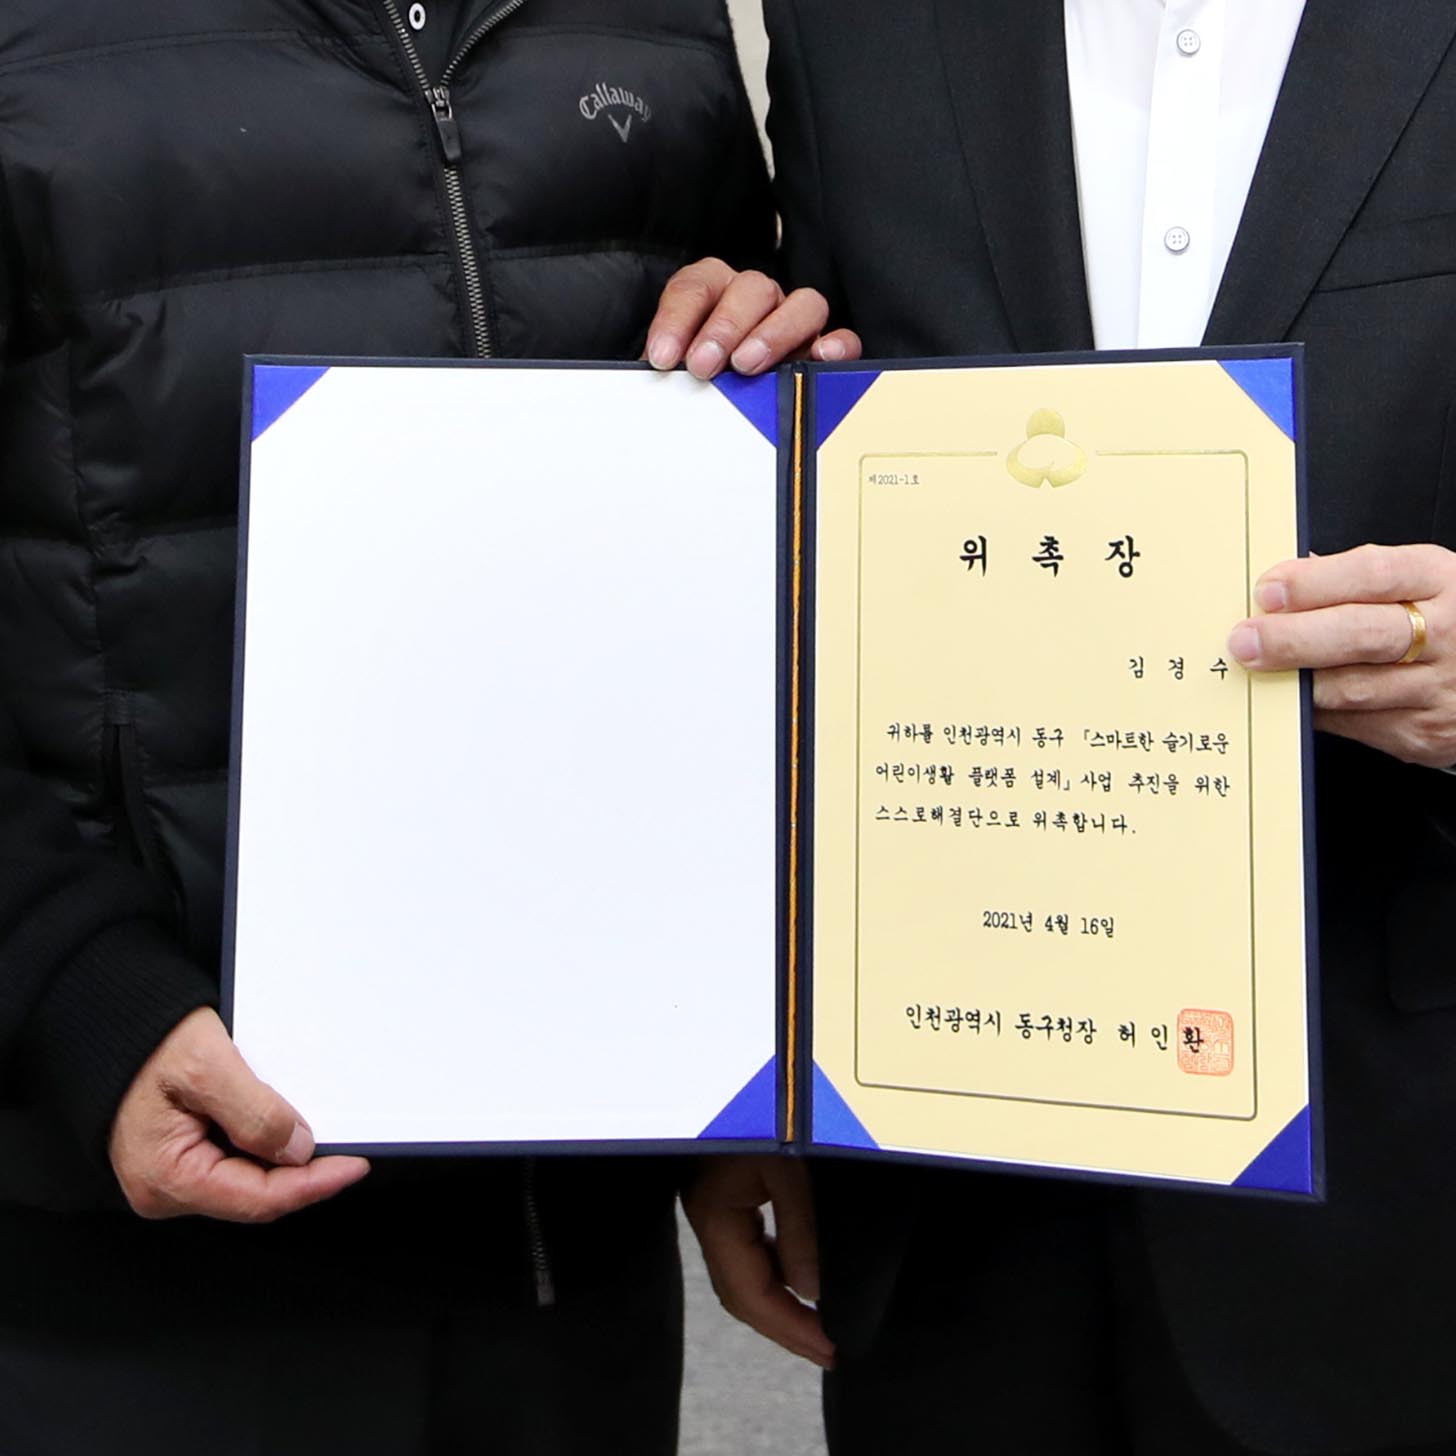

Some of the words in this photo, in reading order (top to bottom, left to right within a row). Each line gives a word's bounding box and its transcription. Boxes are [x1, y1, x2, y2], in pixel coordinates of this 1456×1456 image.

[579, 82, 652, 123] Callaway
[886, 722, 934, 744] 귀하를
[943, 724, 1021, 747] 인천광역시
[1031, 727, 1064, 749] 동구
[1161, 731, 1229, 755] 슬기로운
[875, 762, 955, 786] 어린이생활
[968, 766, 1017, 789] 플랫폼
[1081, 770, 1112, 793] 사업
[1128, 772, 1180, 796] 추진을
[1194, 775, 1231, 798] 위한
[875, 805, 1021, 829] 스스로해결단으로
[1032, 810, 1136, 834] 위촉합니다.
[983, 910, 1033, 933] 2021년
[1044, 914, 1069, 936] 4월
[1081, 917, 1114, 939] 16일
[906, 1003, 1001, 1035] 인천광역시
[1014, 1013, 1097, 1045] 동구청장
